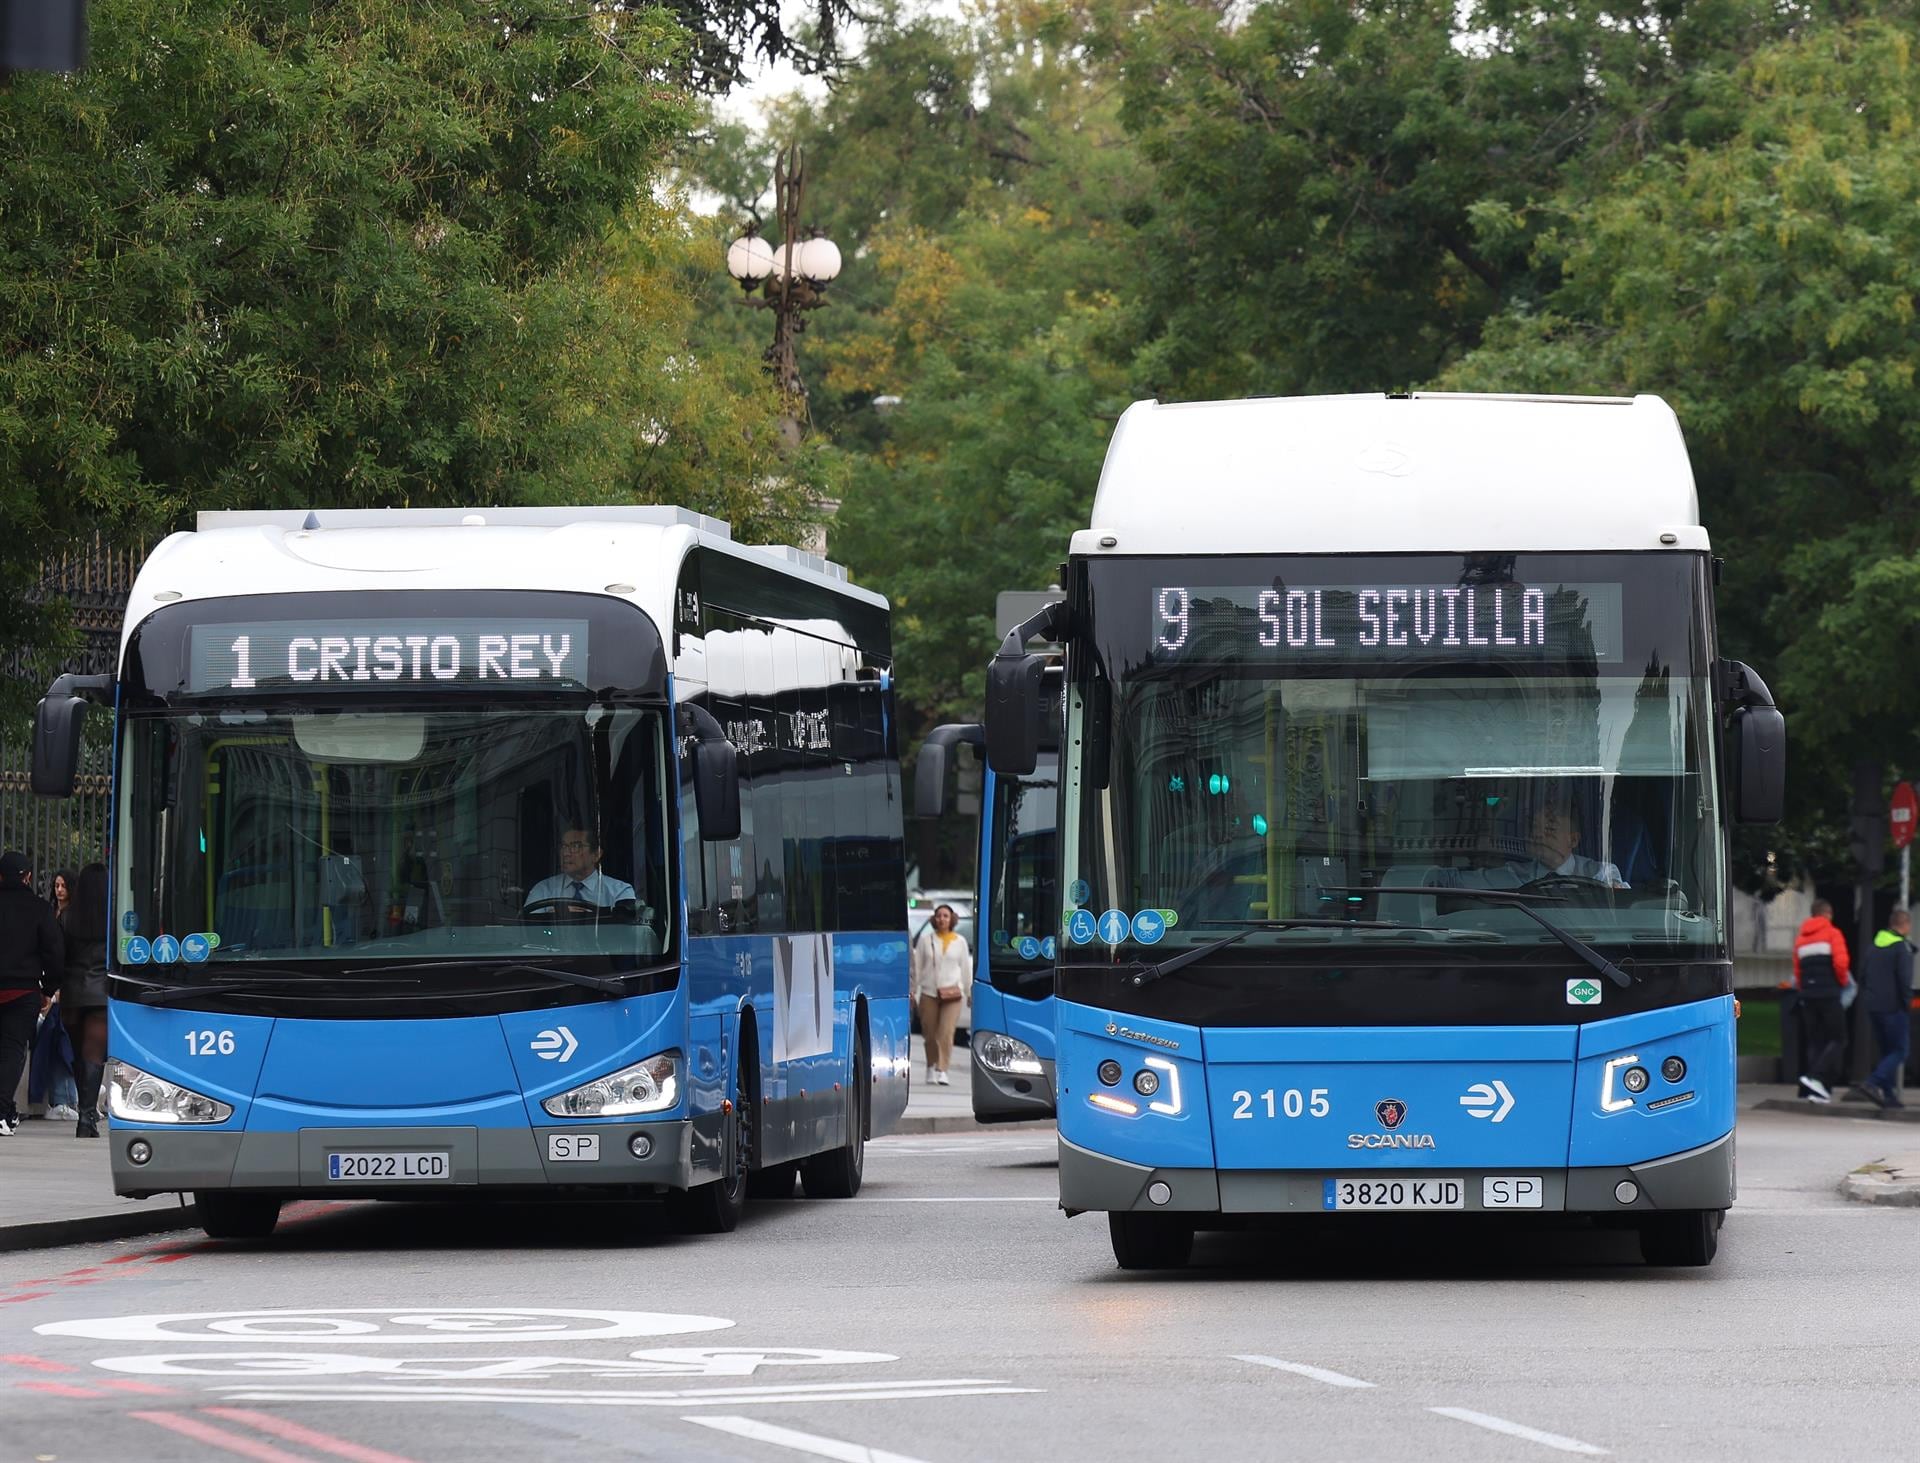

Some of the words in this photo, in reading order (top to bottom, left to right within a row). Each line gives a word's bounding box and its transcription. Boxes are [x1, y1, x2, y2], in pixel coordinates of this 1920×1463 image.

[1159, 586, 1189, 651] 9
[1258, 589, 1336, 647] SOL
[1358, 588, 1545, 646] SEVILLA
[230, 635, 256, 688] 1
[288, 636, 460, 682] CRISTO
[478, 634, 571, 679] REY
[1166, 912, 1173, 922] 2
[1574, 988, 1594, 996] GNC
[184, 1030, 235, 1056] 126
[1232, 1088, 1329, 1120] 2105
[1347, 1133, 1435, 1150] SCANIA
[343, 1157, 396, 1176] 2022
[404, 1156, 443, 1175] LCD
[1342, 1182, 1404, 1205] 3820
[1413, 1182, 1459, 1205] KJD
